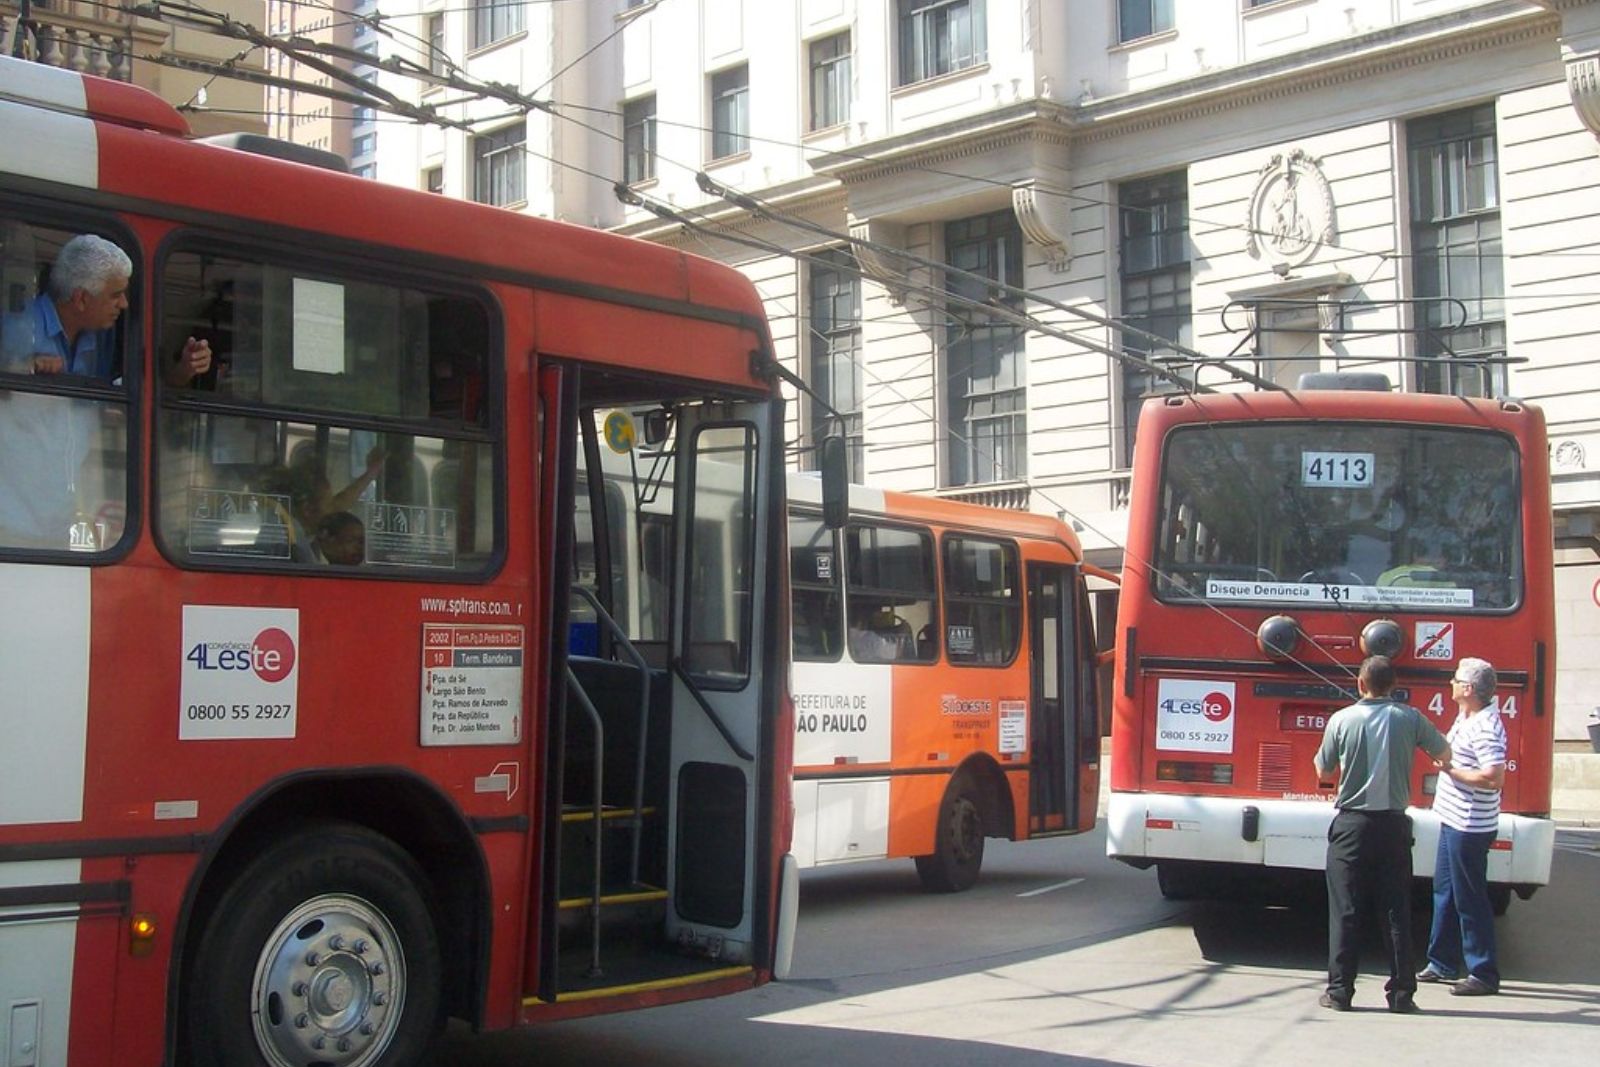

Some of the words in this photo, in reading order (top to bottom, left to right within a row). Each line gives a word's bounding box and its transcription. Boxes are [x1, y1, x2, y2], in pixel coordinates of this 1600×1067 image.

[1309, 458, 1367, 482] 4113
[1210, 584, 1251, 596] Disque
[1254, 585, 1310, 597] Denúncia
[1322, 586, 1350, 600] 181
[429, 632, 449, 644] 2002
[433, 653, 444, 664] 10
[461, 653, 480, 664] Term.
[483, 653, 513, 664] Bandeira
[1418, 648, 1451, 658] ERIGO
[432, 687, 452, 697] Largo
[453, 686, 466, 695] São
[467, 686, 486, 695] Bento
[448, 699, 470, 707] Ramos
[472, 699, 480, 707] de
[481, 698, 508, 707] Azevedo
[793, 694, 851, 709] REFEITURA
[853, 695, 867, 709] DE
[188, 705, 226, 720] 0800
[231, 705, 250, 719] 55
[255, 704, 292, 719] 2927
[458, 711, 489, 721] República
[459, 723, 475, 732] João
[476, 722, 501, 731] Mendes
[795, 710, 818, 732] ÃO
[822, 713, 867, 733] PAULO
[1160, 730, 1185, 740] 0800
[1188, 731, 1201, 740] 55
[1204, 733, 1229, 742] 2927
[1282, 791, 1326, 802] Mantenha
